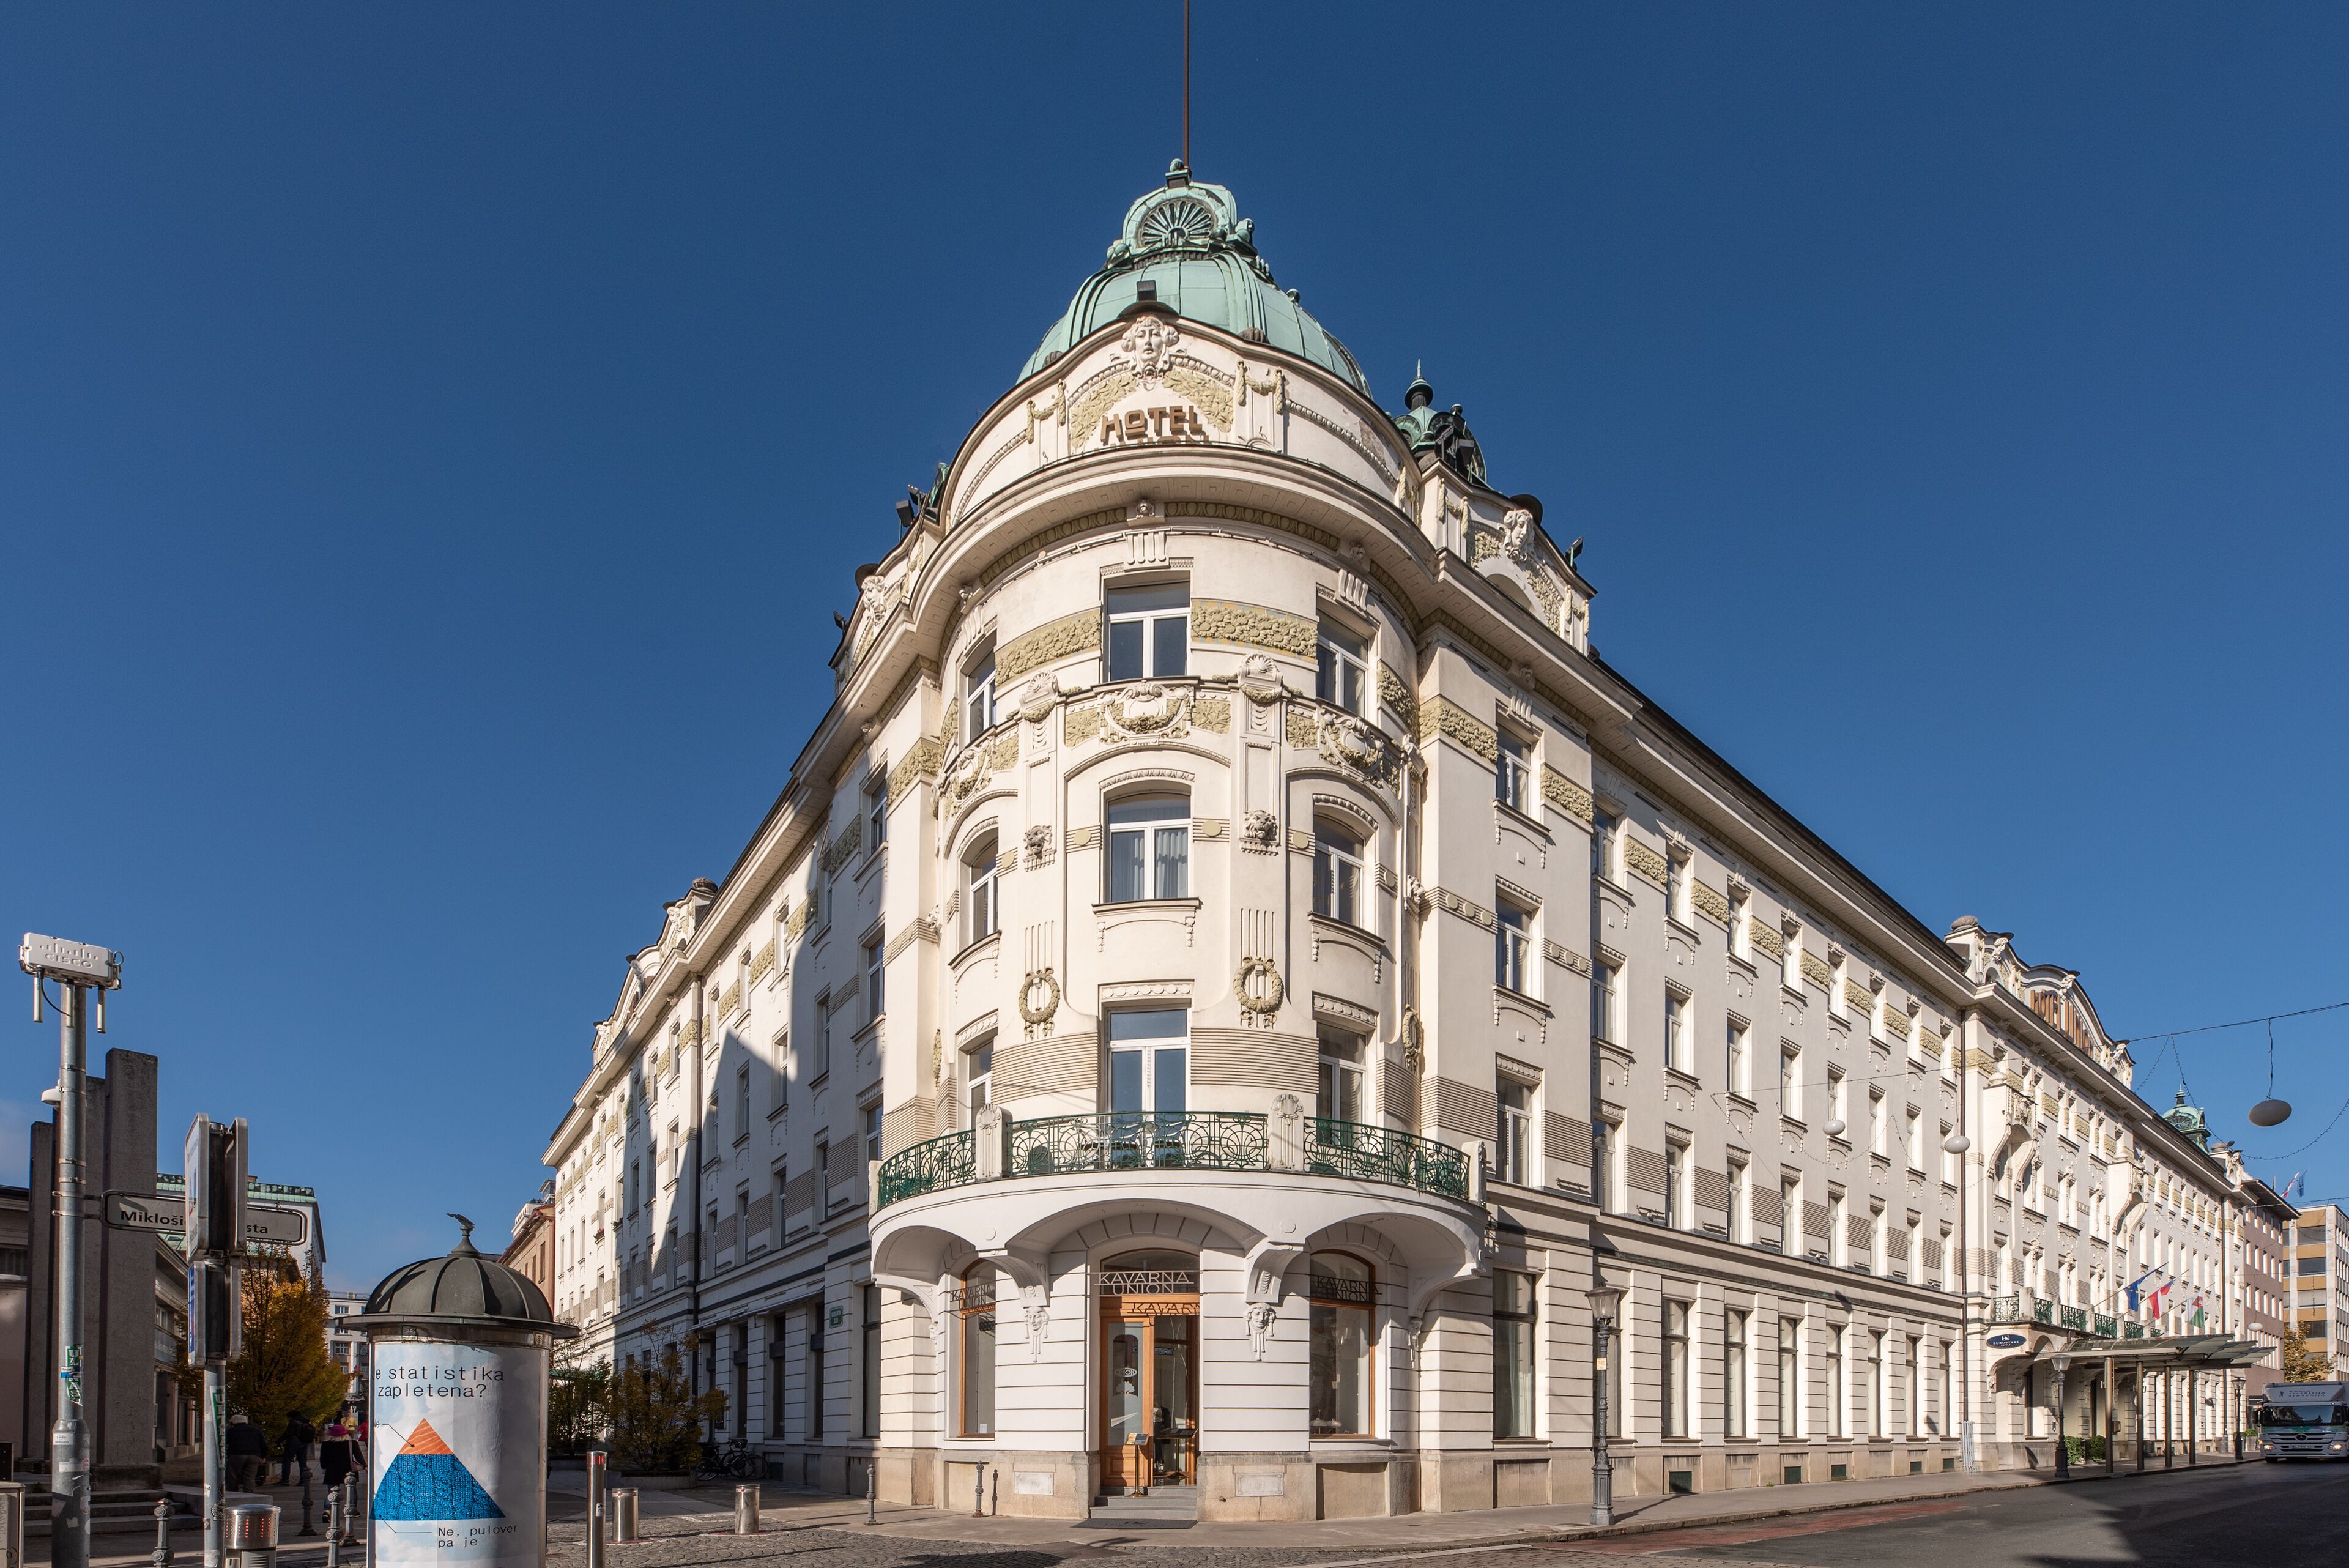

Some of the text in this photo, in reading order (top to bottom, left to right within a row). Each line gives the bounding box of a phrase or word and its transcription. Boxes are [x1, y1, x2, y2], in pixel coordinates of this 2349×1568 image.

[1100, 405, 1203, 442] HOTEL
[45, 953, 93, 968] CISCO
[120, 1209, 186, 1225] Mikloši
[1098, 1271, 1190, 1284] KAVARNA
[951, 1283, 992, 1302] KAVARNA
[1112, 1283, 1174, 1296] UNION
[388, 1365, 505, 1381] statistika
[377, 1383, 487, 1399] zapletena?
[438, 1525, 518, 1537] Ne, pulover
[438, 1537, 478, 1548] pa je
